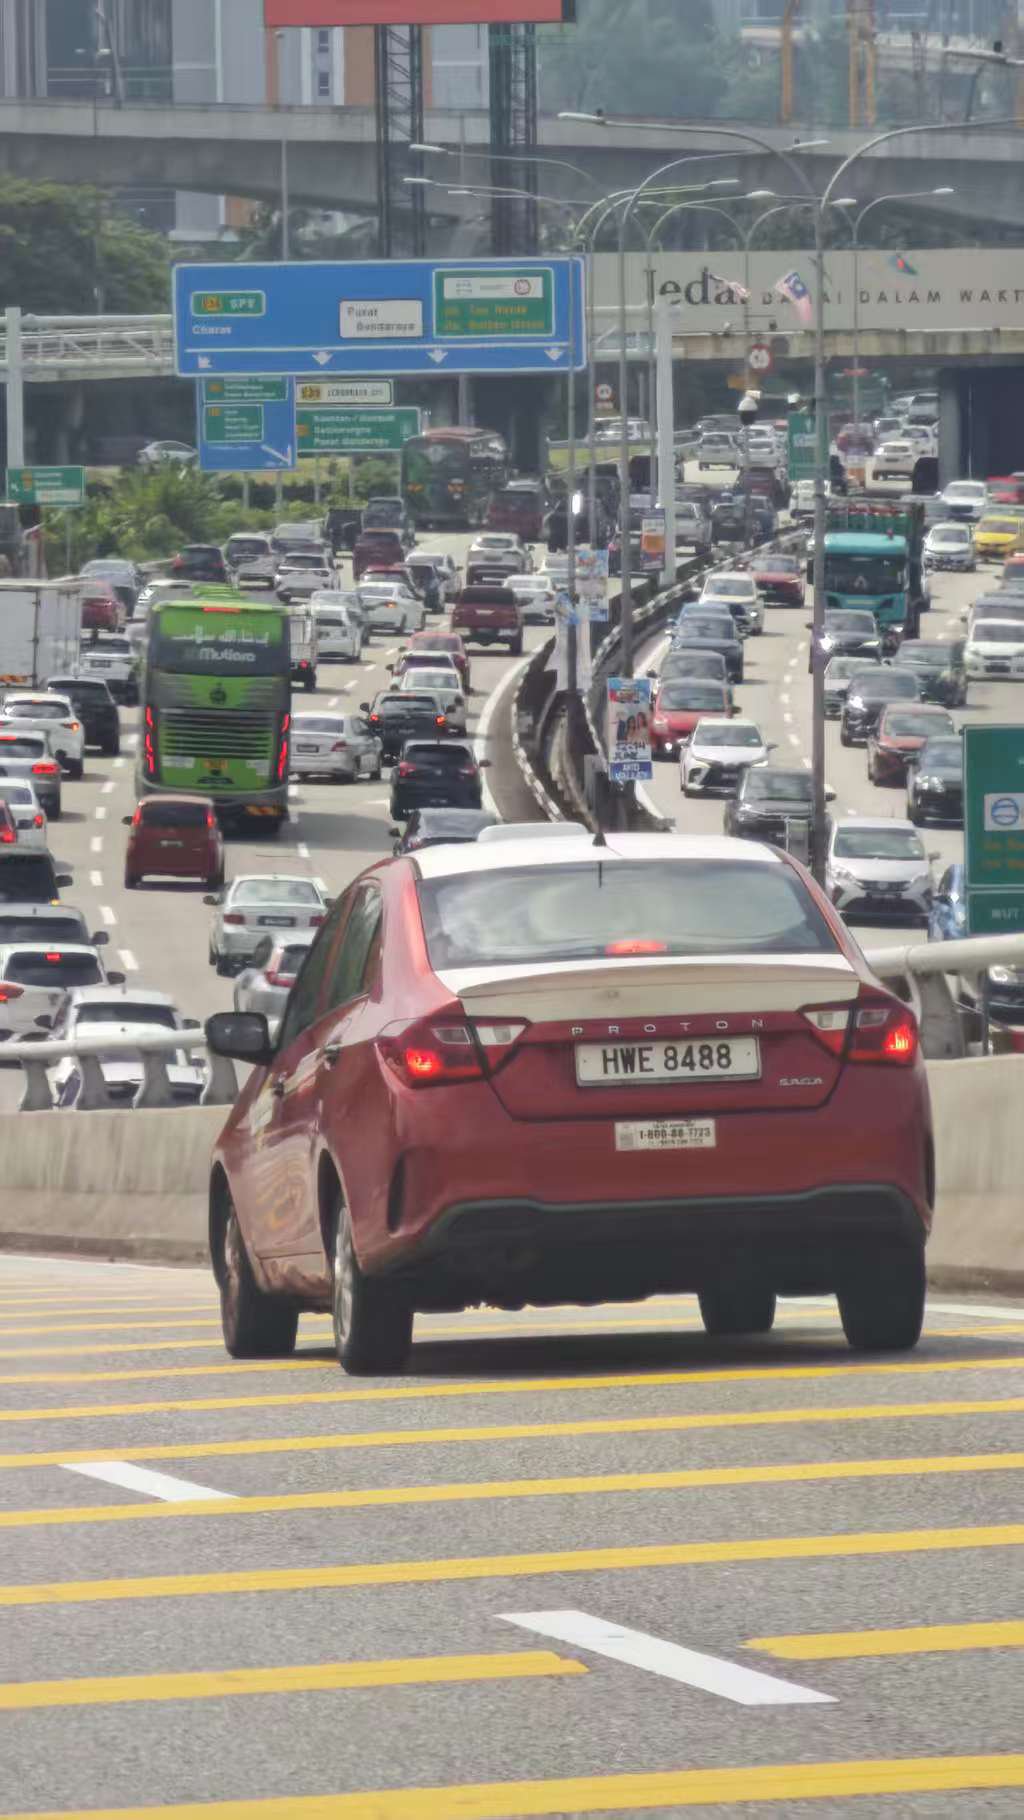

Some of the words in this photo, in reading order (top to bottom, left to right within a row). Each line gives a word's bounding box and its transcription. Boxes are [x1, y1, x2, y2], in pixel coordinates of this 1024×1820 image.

[859, 290, 941, 303] DALAM
[571, 1019, 764, 1036] PROTON
[602, 1046, 654, 1074] HWE
[663, 1043, 732, 1071] 8488
